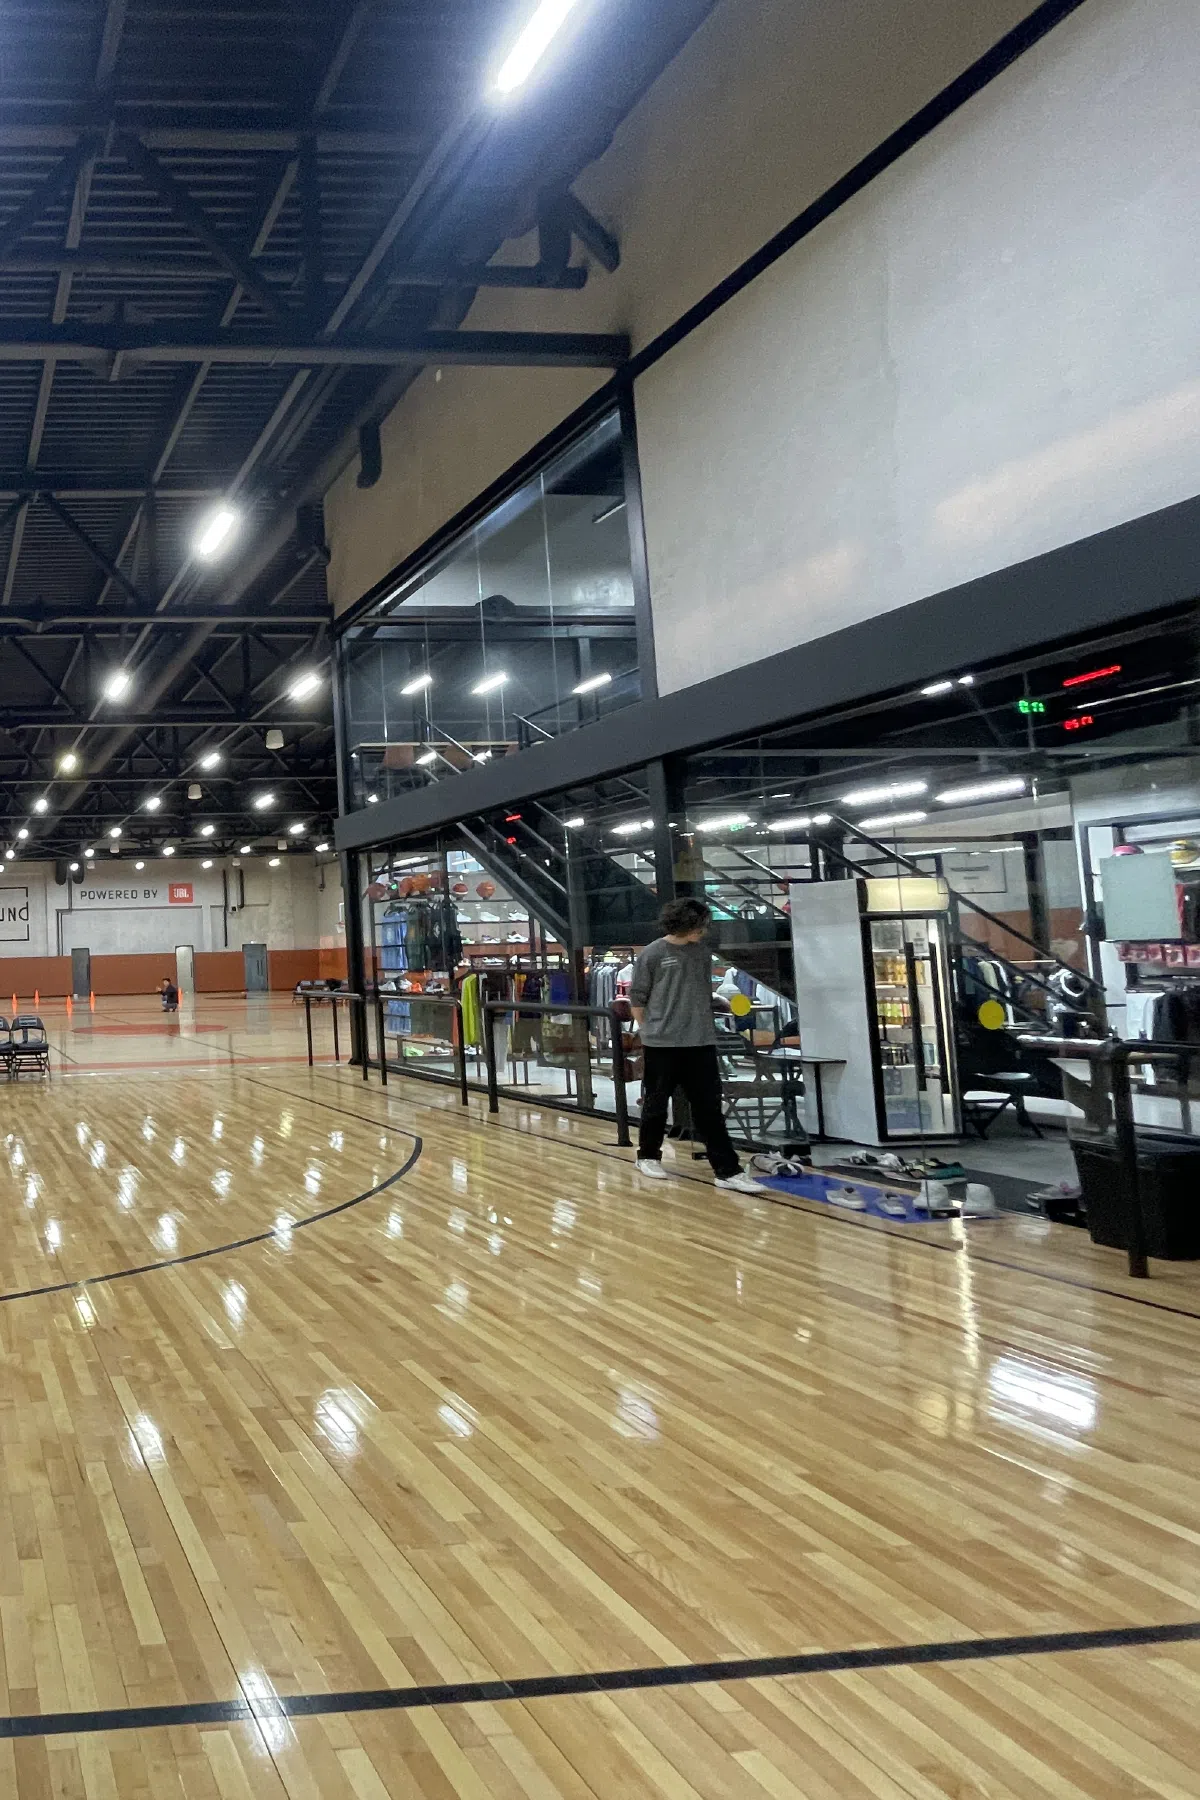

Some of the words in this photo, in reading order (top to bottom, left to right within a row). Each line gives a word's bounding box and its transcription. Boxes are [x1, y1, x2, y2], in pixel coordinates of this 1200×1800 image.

[80, 889, 138, 901] POWERED
[143, 888, 158, 899] BY
[172, 887, 190, 899] JBL
